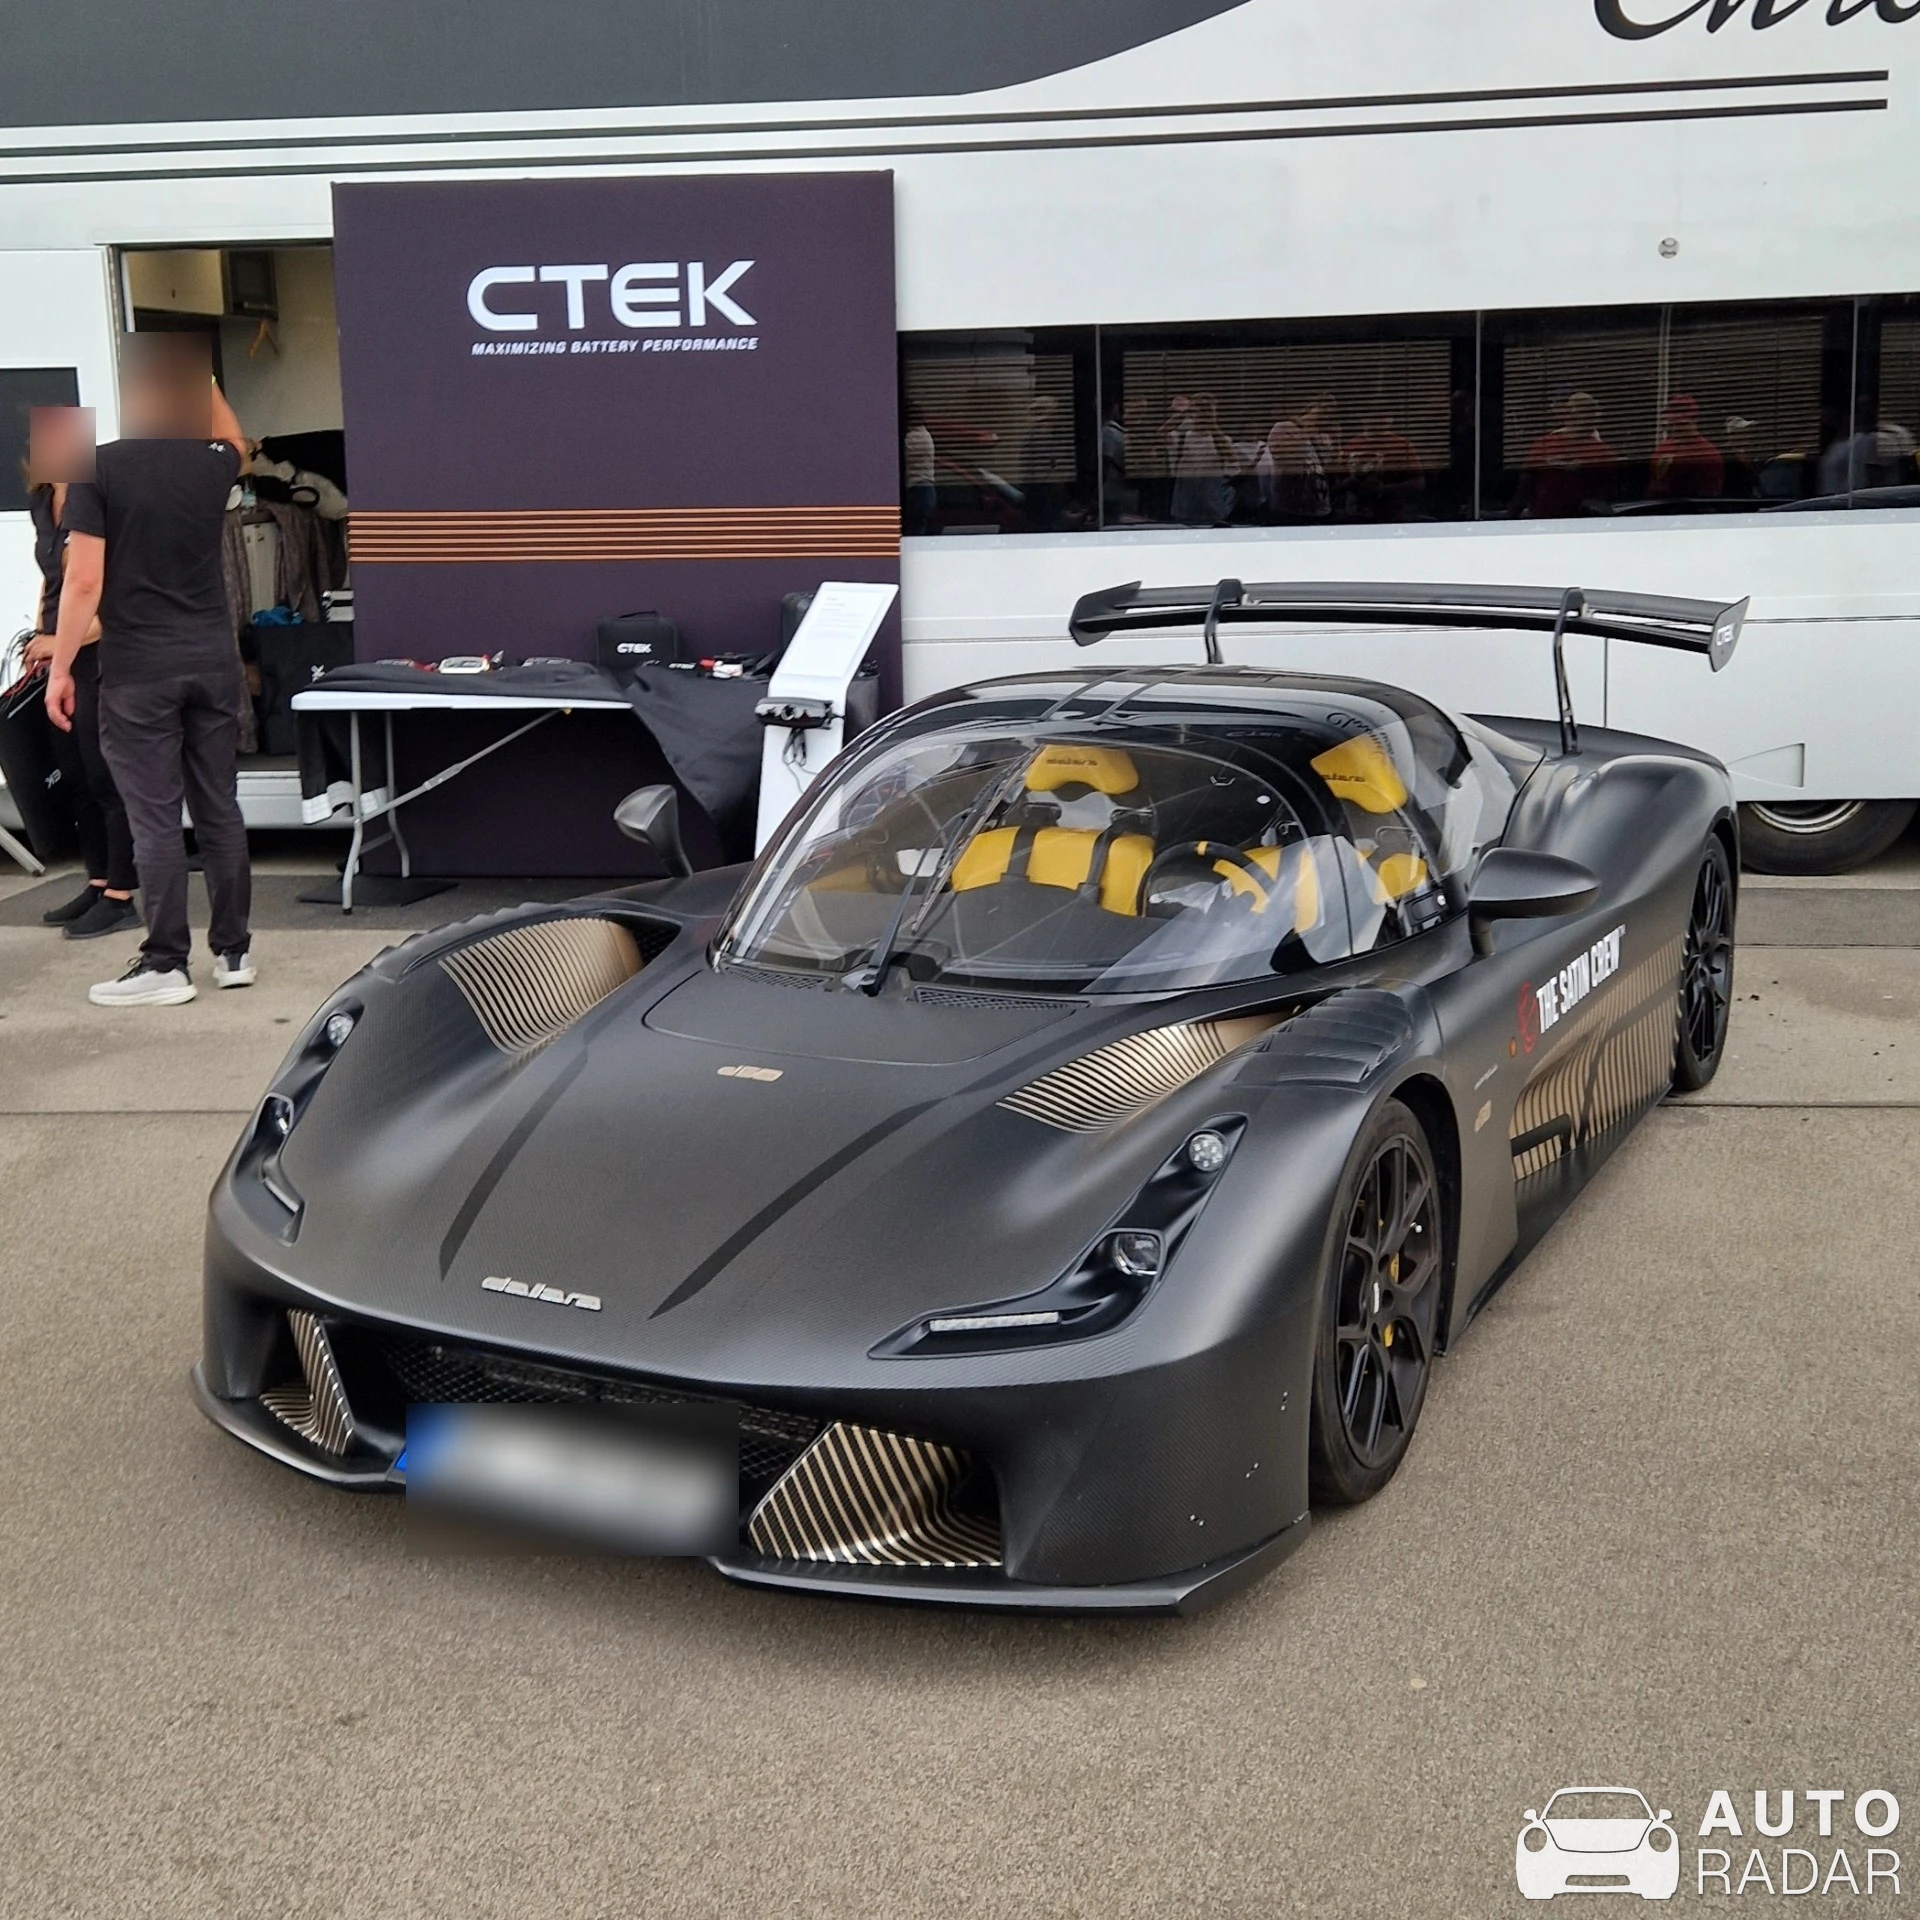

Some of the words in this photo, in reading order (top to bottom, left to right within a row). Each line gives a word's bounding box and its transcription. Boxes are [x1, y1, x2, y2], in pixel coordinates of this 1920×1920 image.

[467, 260, 758, 331] CTEK
[471, 341, 566, 356] MAXIMIZING
[570, 339, 638, 354] BATTERY
[642, 337, 760, 352] PERFORMANCE
[1536, 976, 1560, 1034] THE
